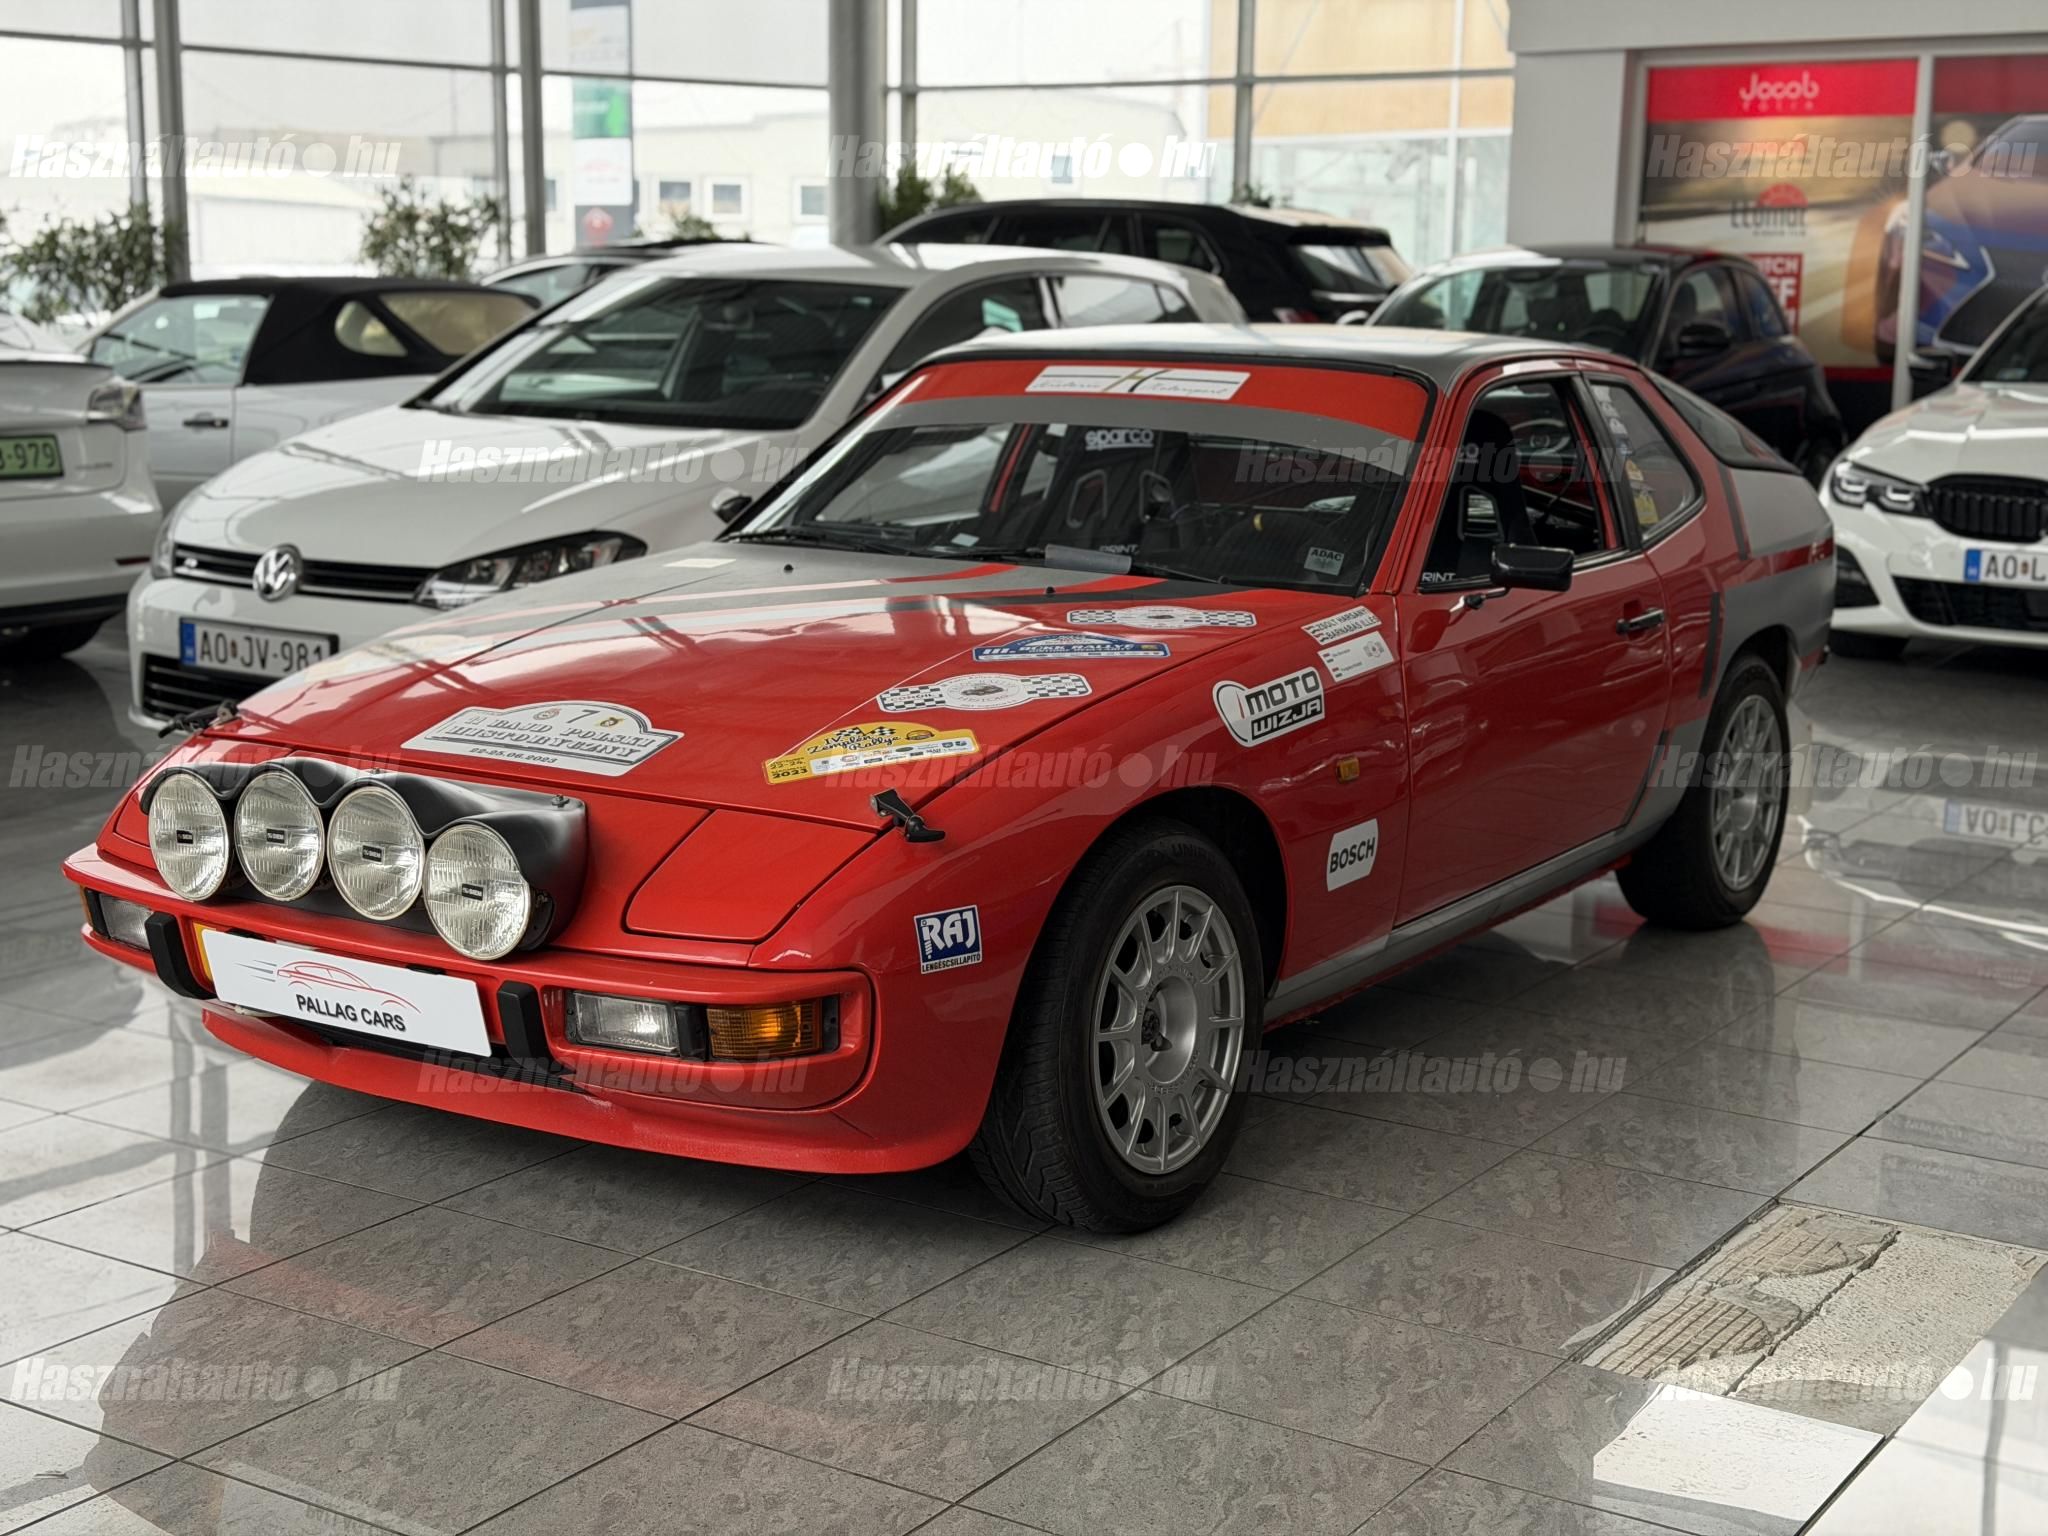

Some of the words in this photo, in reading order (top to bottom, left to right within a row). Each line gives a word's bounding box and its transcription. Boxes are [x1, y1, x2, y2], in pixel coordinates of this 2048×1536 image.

[1311, 548, 1342, 562] ADAC
[1244, 670, 1320, 716] MOTO
[1253, 697, 1323, 737] WIZJA
[1329, 838, 1376, 874] BOSCH
[920, 909, 976, 959] RAJ
[295, 993, 359, 1024] PALLAG
[361, 1007, 407, 1032] CARS
